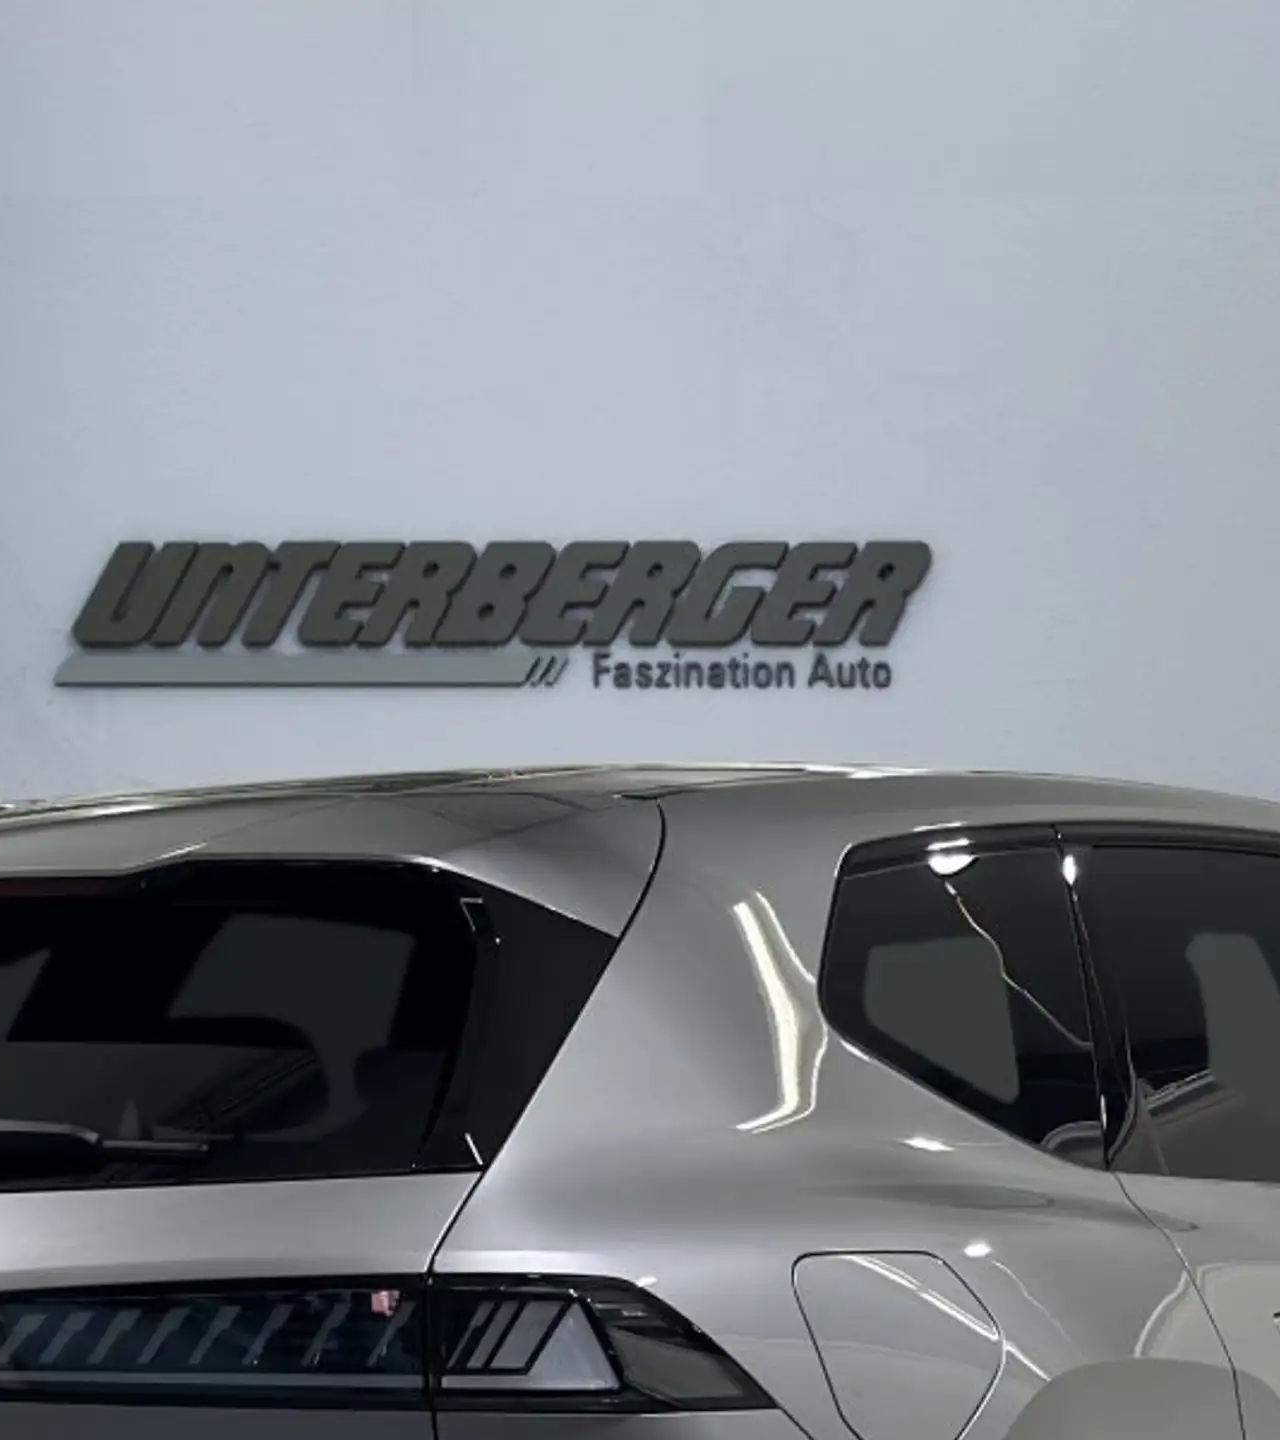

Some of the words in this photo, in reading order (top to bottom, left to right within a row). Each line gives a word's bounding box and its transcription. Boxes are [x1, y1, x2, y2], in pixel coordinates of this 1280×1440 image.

[70, 540, 932, 650] UNTERBERGER
[591, 653, 795, 690] Faszination
[807, 653, 893, 690] Auto
